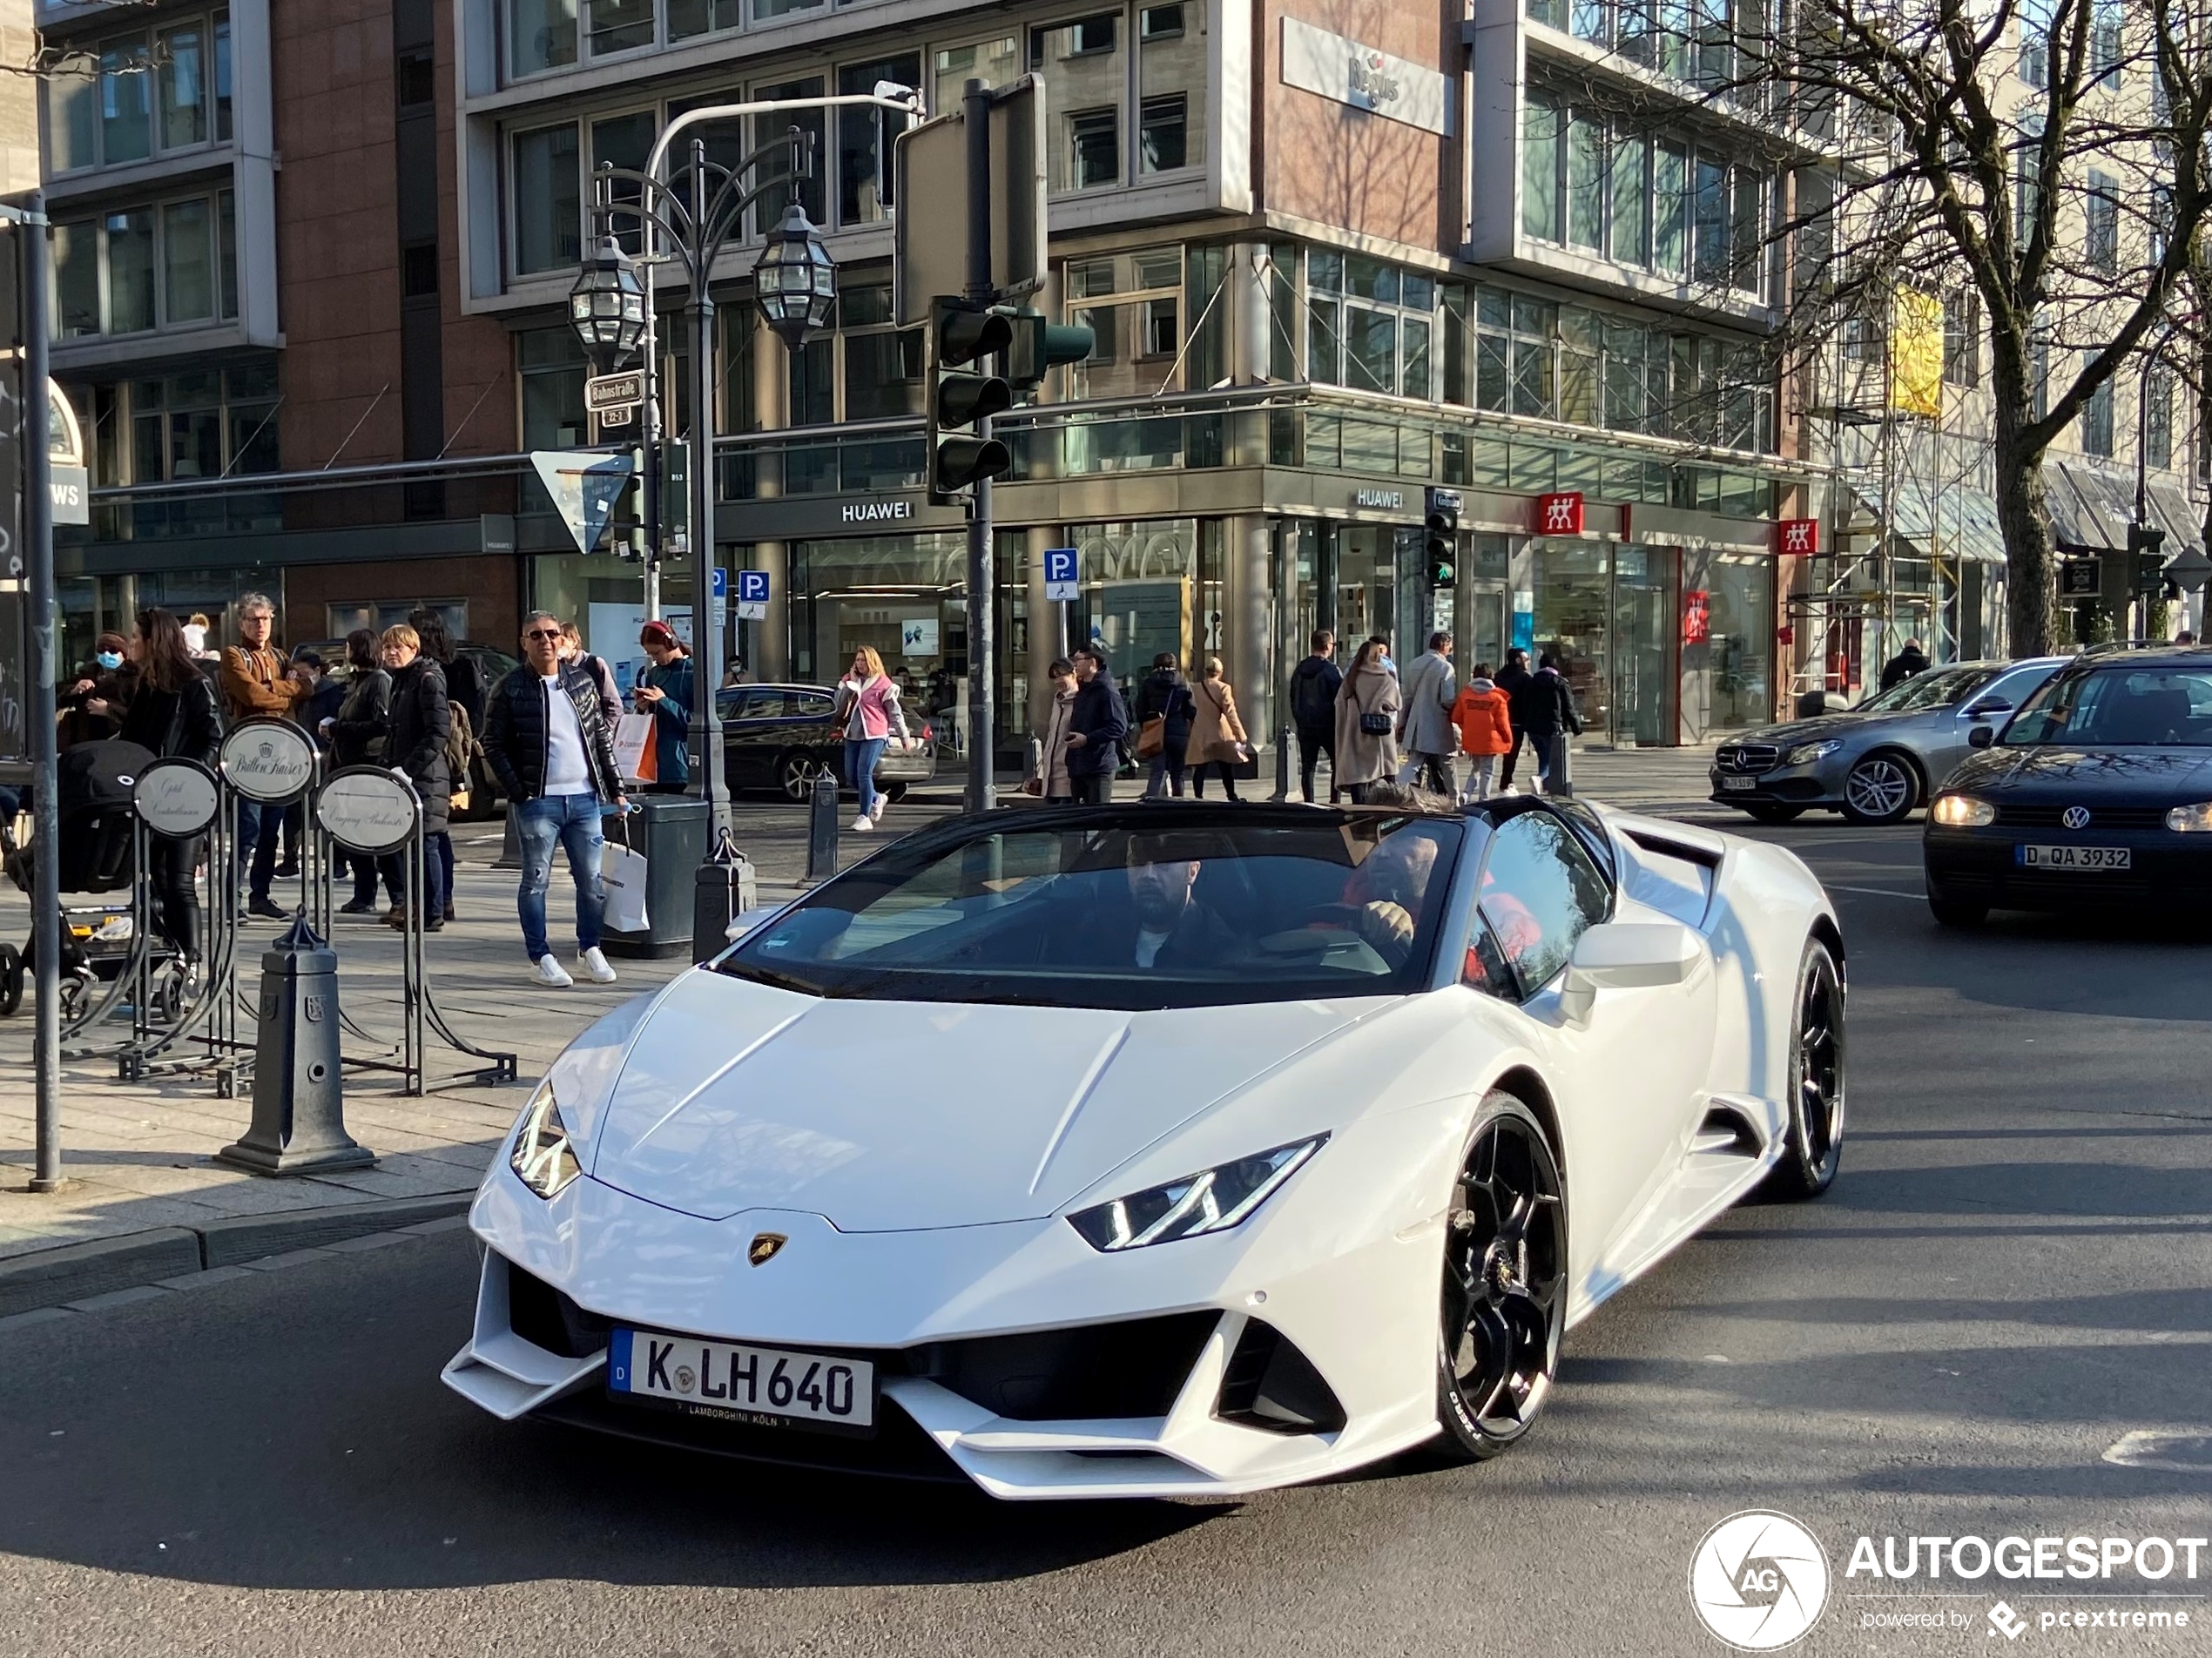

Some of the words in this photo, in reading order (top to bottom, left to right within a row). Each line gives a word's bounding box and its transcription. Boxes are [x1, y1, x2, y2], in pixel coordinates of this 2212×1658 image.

[1348, 57, 1399, 108] Regus
[592, 381, 636, 401] Bahnstraße
[1358, 489, 1404, 509] HUAWEI
[842, 502, 910, 522] HUAWEI
[1051, 554, 1070, 580] P
[746, 575, 764, 599] P
[2026, 846, 2038, 864] D
[2051, 848, 2075, 865] QA
[2080, 849, 2129, 867] 3932
[617, 1366, 624, 1380] D
[648, 1340, 674, 1391] K
[689, 1405, 748, 1422] LAMBORGHINI
[752, 1414, 778, 1426] KÖLN
